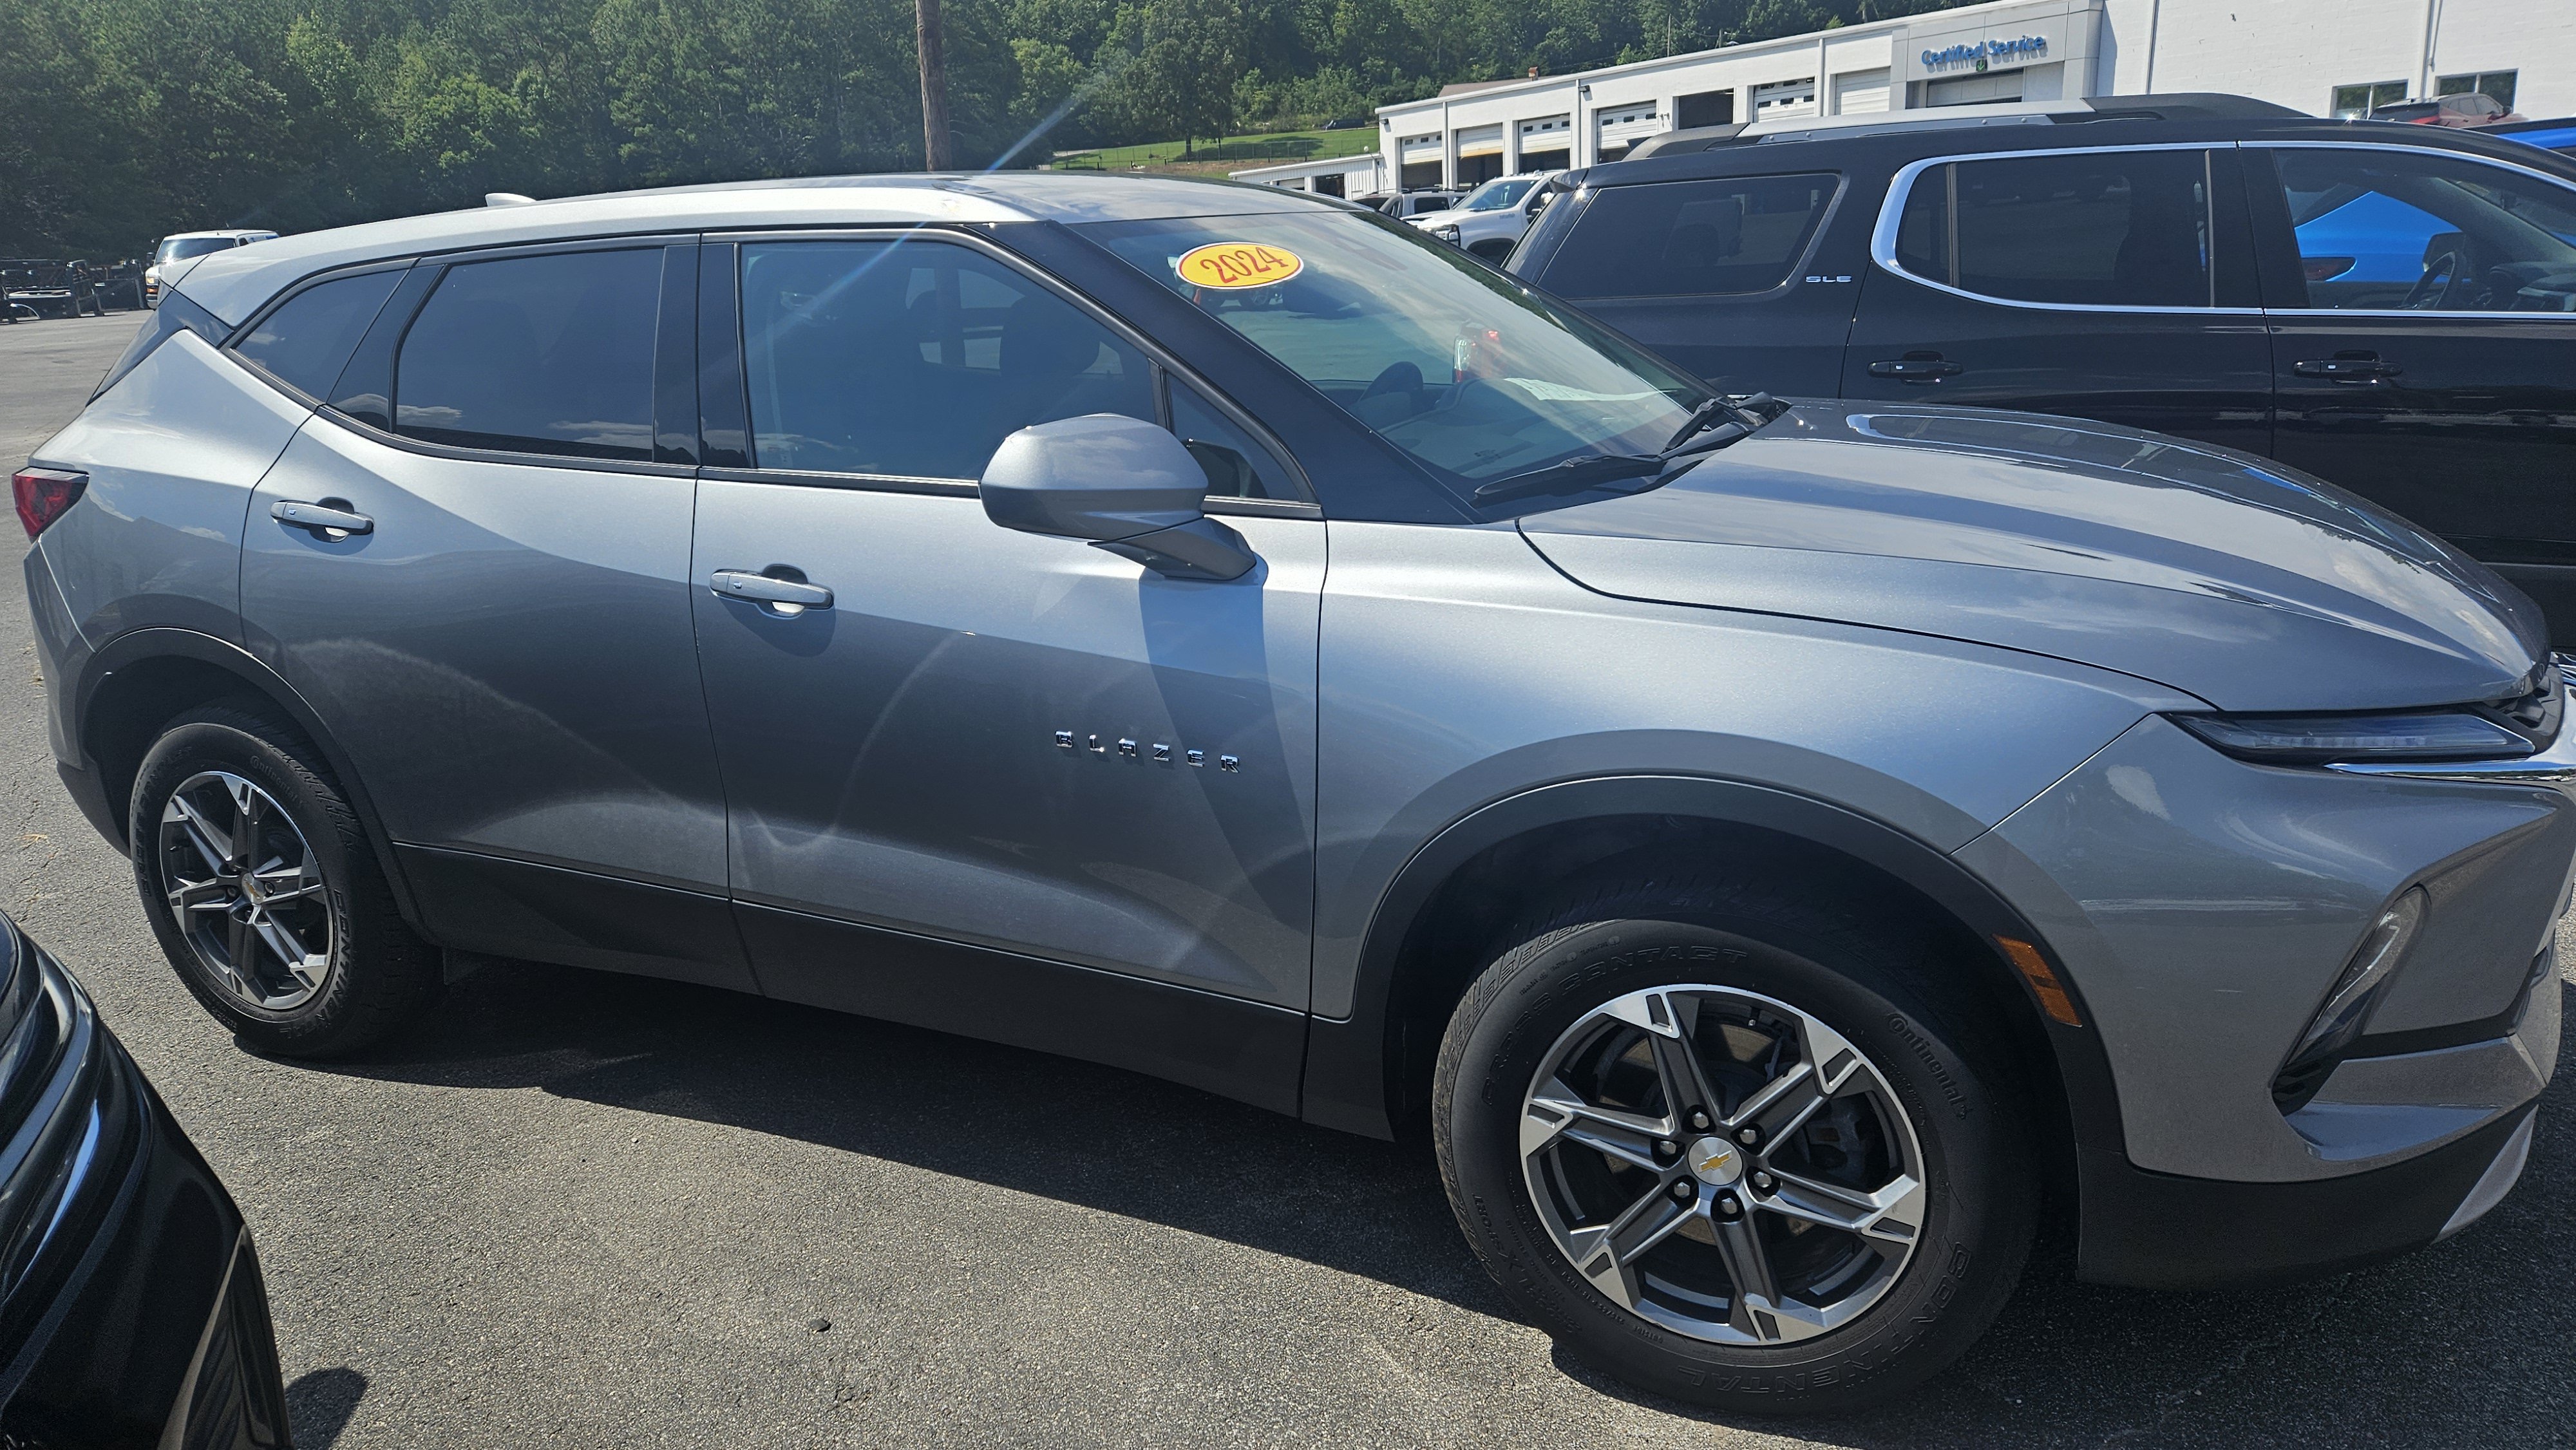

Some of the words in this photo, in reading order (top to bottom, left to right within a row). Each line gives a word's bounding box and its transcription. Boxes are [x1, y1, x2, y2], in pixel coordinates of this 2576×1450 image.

[1921, 41, 1984, 65] Certified
[1987, 35, 2045, 56] Service
[1200, 247, 1289, 283] 2024
[1054, 730, 1240, 773] BLAZER
[1557, 945, 1748, 997] CONTACT
[1886, 1012, 1967, 1106] Continental
[1677, 1241, 1972, 1393] CONTINENTAL
